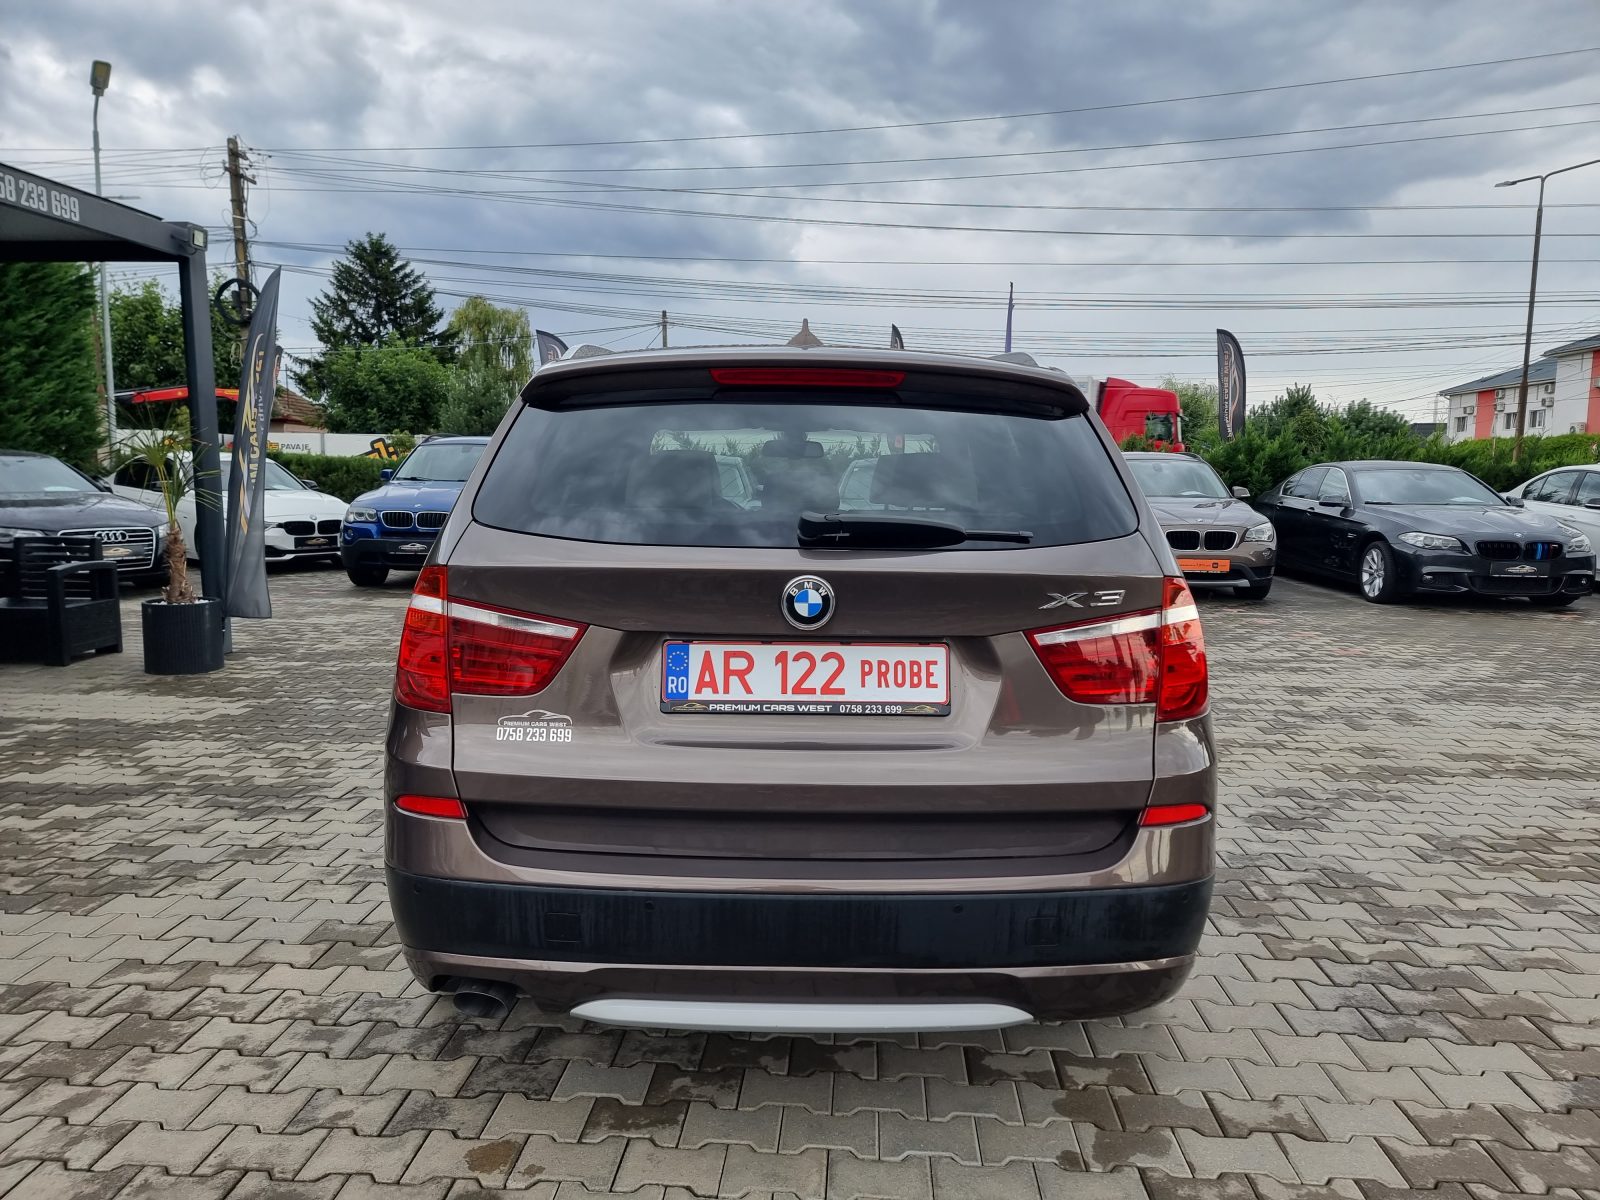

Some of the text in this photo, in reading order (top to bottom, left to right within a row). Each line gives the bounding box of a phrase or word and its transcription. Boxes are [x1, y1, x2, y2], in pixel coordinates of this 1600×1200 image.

[19, 179, 48, 212] 233
[51, 190, 80, 222] 699
[789, 581, 828, 598] BMW
[1038, 589, 1126, 610] X3
[668, 650, 939, 696] RO AR 122 PROBE
[709, 703, 902, 715] PREMIUM CARS WEST 0758 233 699
[496, 727, 572, 743] 0758 233 699
